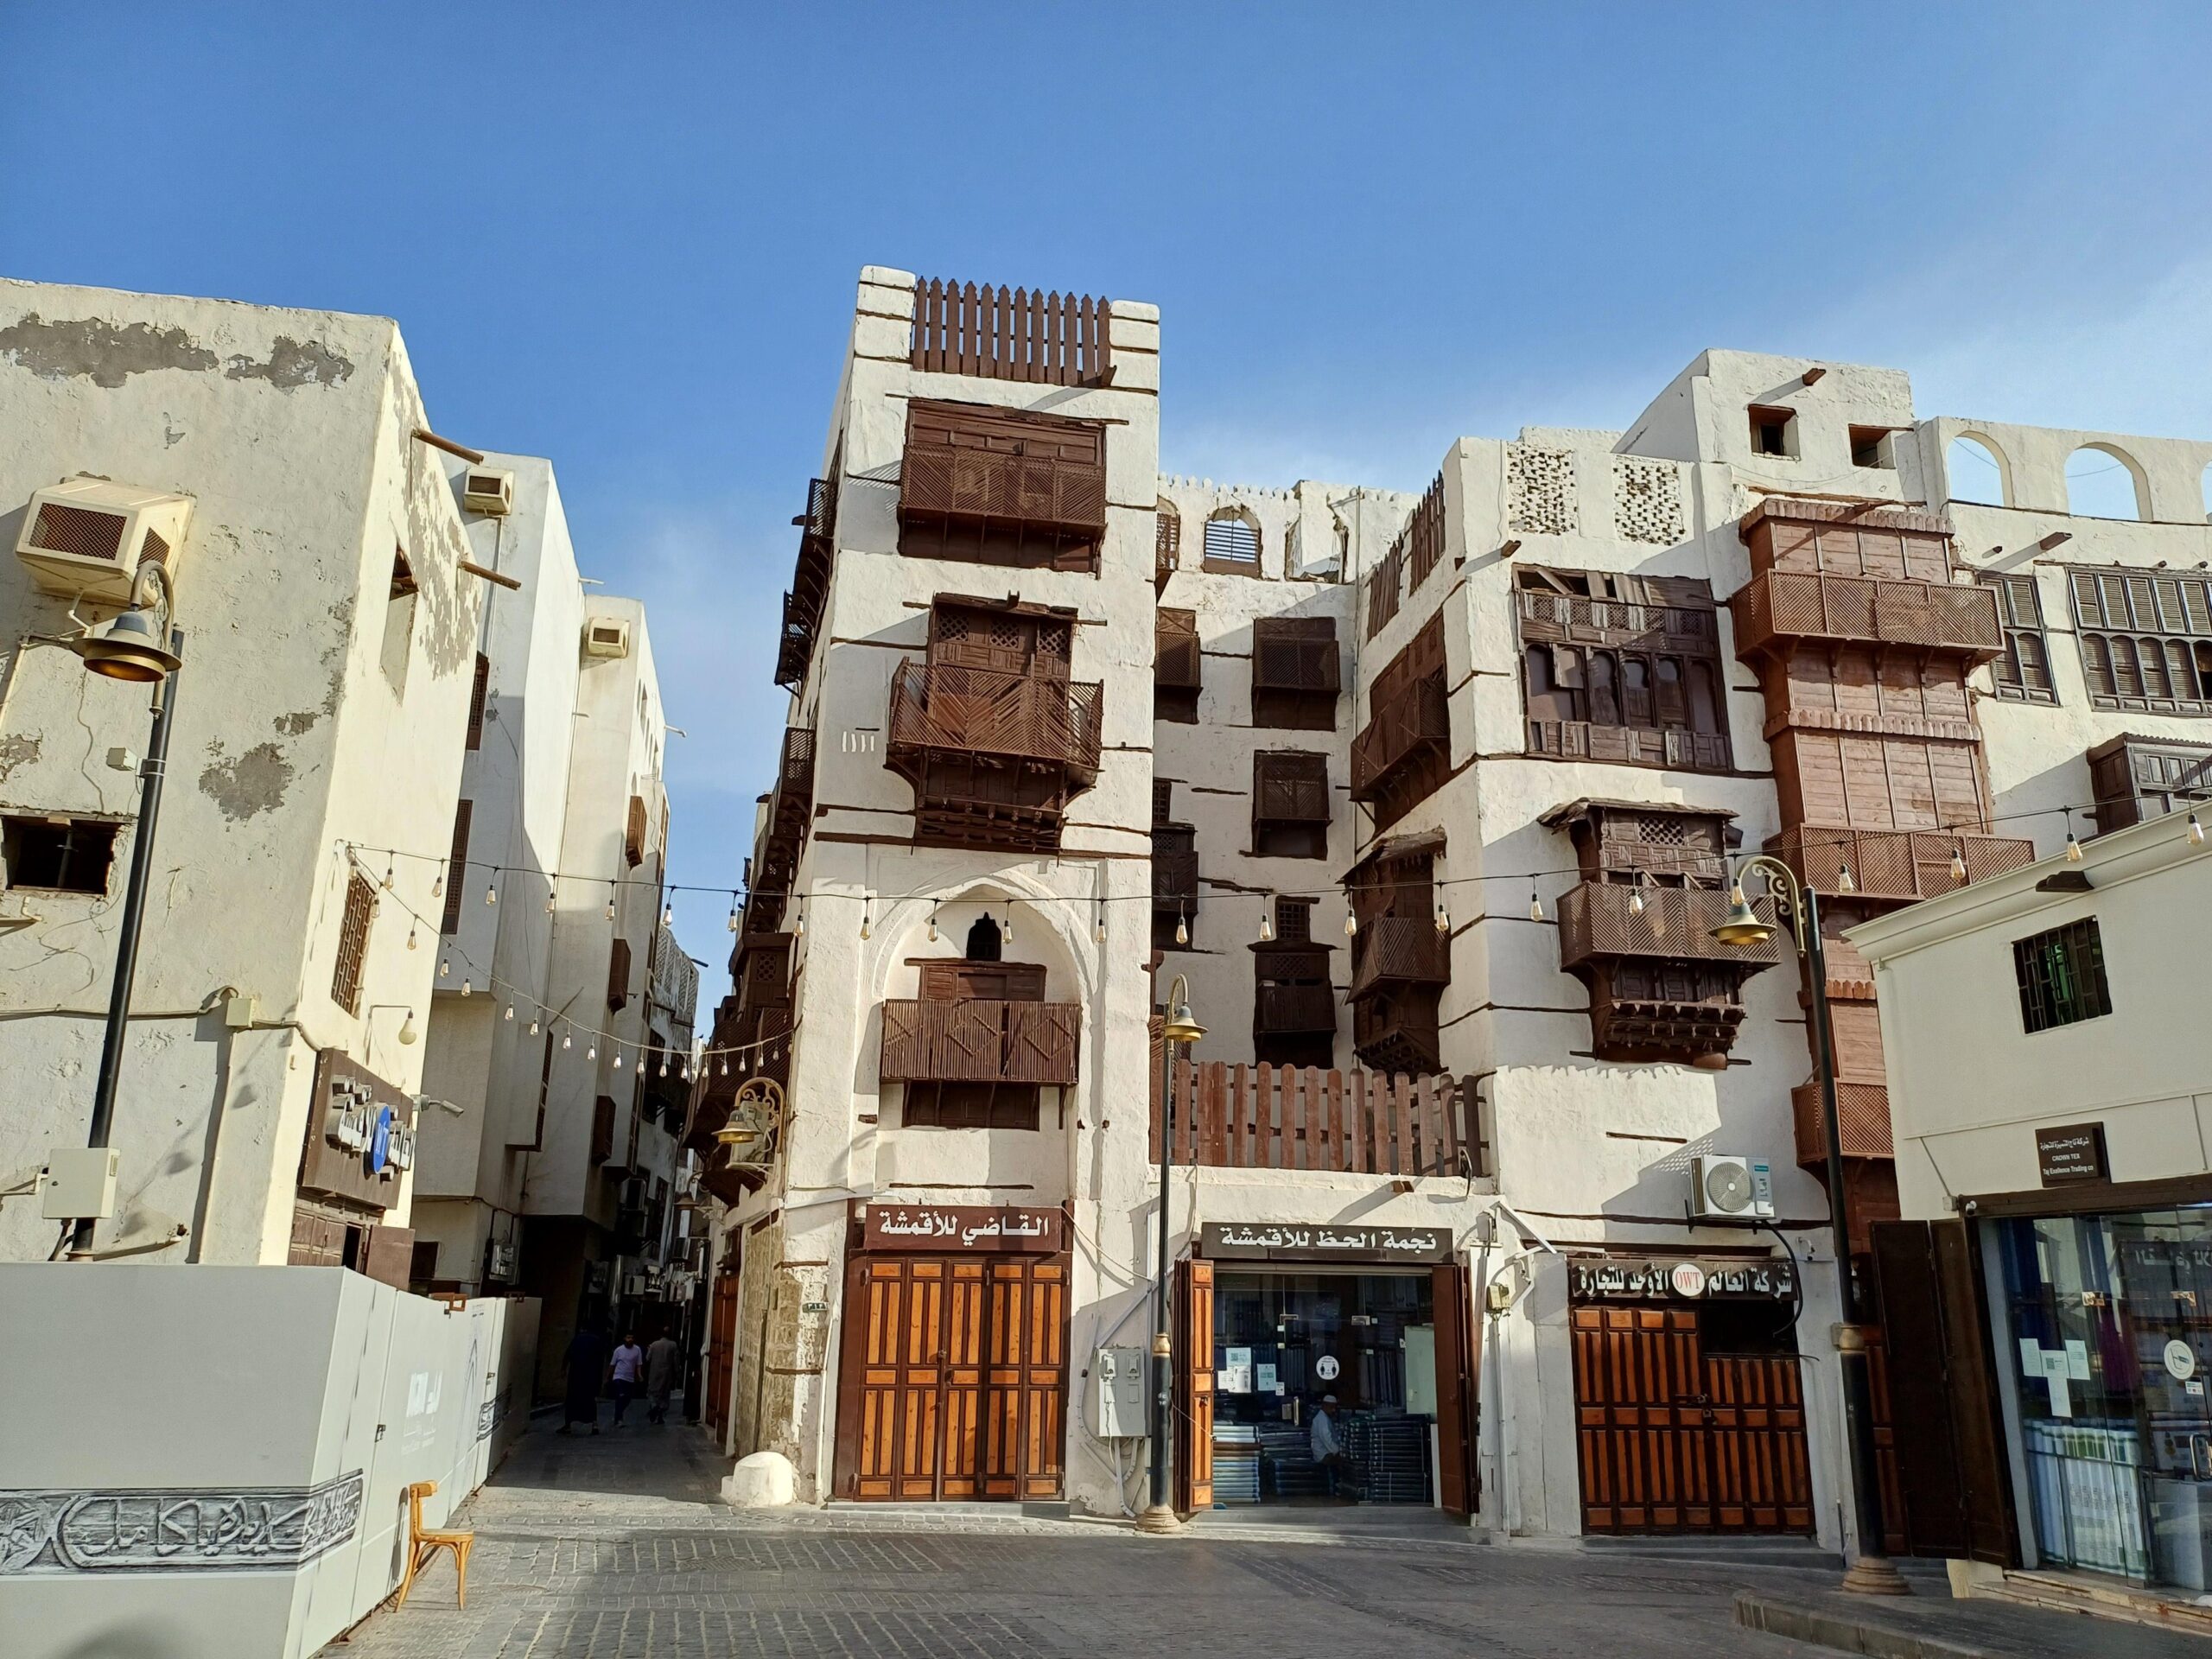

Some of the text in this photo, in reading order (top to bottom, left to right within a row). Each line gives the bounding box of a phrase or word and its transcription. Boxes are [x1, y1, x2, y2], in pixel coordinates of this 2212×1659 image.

[880, 1210, 1049, 1246] القاضي للأقمشة
[1219, 1226, 1437, 1254] نجمة الحظ للأقمشة
[1579, 1265, 1625, 1296] للتجارة
[1675, 1270, 1700, 1291] OWT
[1708, 1265, 1792, 1298] شركة العالم
